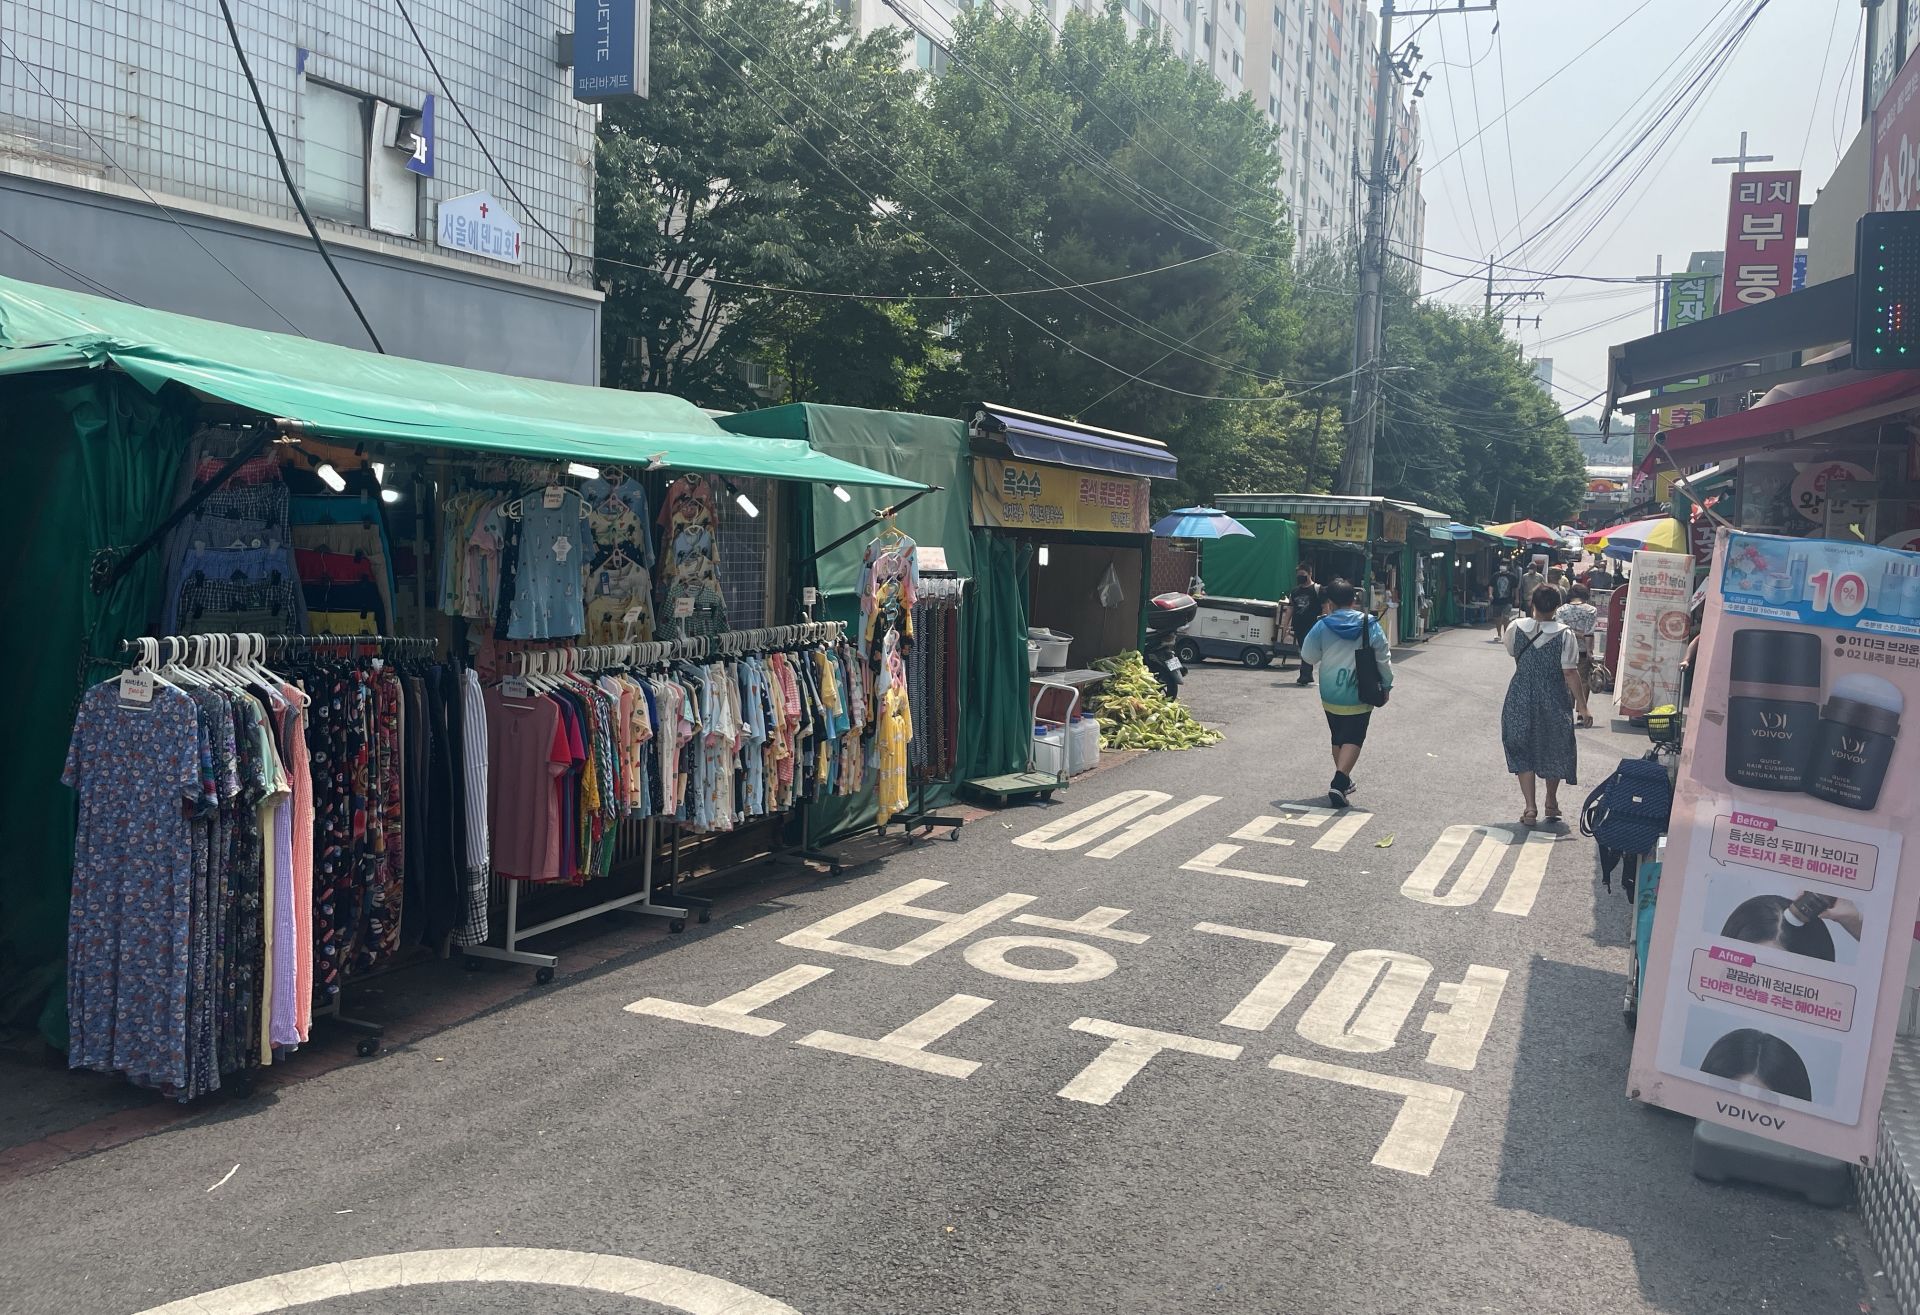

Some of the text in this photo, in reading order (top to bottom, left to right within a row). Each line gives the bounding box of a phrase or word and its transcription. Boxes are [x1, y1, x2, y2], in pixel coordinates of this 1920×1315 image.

[579, 74, 629, 91] 파리바게뜨
[1739, 181, 1792, 204] 리치
[442, 213, 514, 259] 서울에덴교회
[1003, 466, 1041, 499] 옥수수
[1080, 478, 1098, 507] 즉석
[1846, 649, 1861, 659] 02
[1863, 651, 1896, 665] 내추럴
[1848, 636, 1920, 655] 01 다크 브라운
[1751, 729, 1793, 741] VDIVOV
[1746, 762, 1795, 773] HAIR CUSHION
[1831, 749, 1868, 765] VDIVOV
[1736, 814, 1770, 829] Before
[1012, 790, 1556, 916] 어린이
[1727, 843, 1857, 880] 정돈되지 못한 헤어라인
[1729, 829, 1859, 866] 듬성듬성 두피가 보이고
[1718, 950, 1745, 964] After
[1725, 967, 1819, 1001] 깔끔하게 정리되어
[1700, 976, 1842, 1022] 단아한 인상을 주는 헤어라인
[623, 879, 1509, 1175] 보호구역
[1716, 1101, 1786, 1130] VDIVOV
